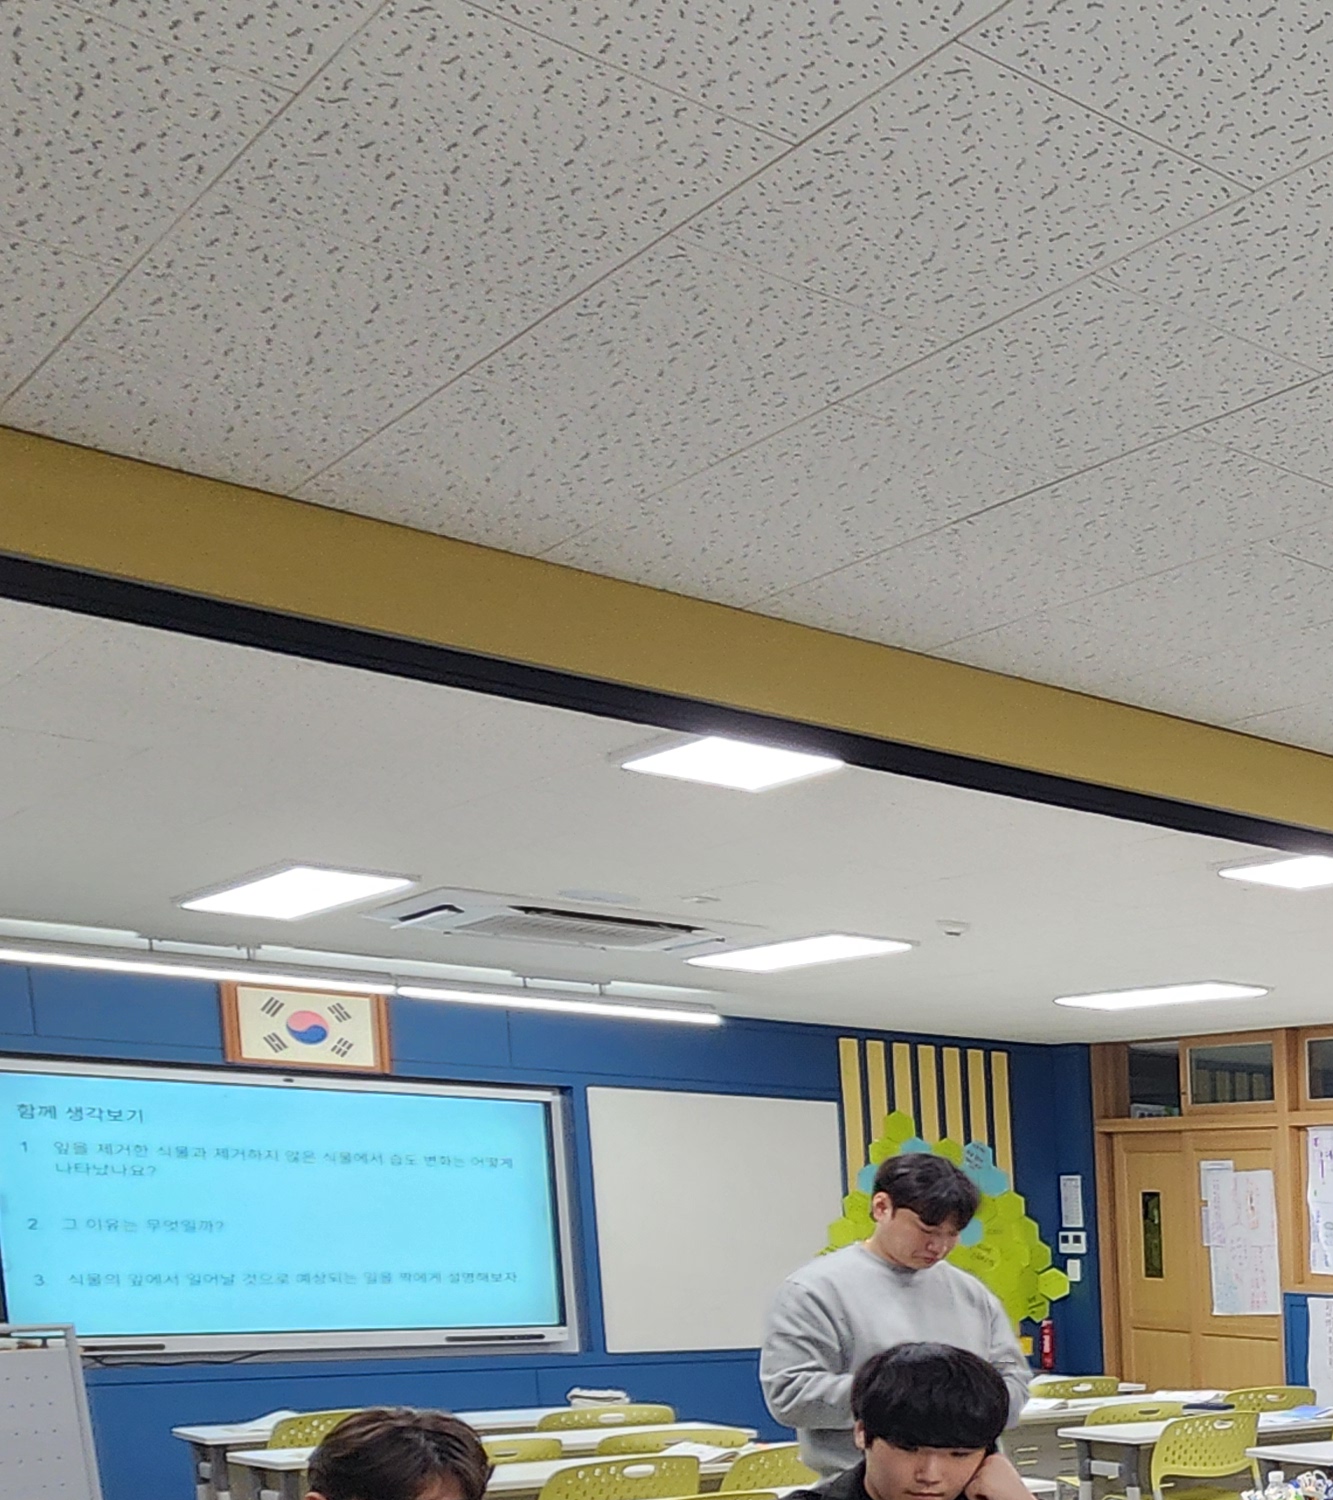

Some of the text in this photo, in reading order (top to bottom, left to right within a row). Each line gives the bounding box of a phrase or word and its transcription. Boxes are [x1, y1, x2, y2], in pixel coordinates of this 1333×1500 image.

[16, 1103, 144, 1124] 함께 생각보기
[53, 1141, 88, 1156] 잎을
[97, 1143, 149, 1158] 제거한
[157, 1145, 207, 1160] 식물과
[214, 1147, 279, 1162] 제거하지
[284, 1150, 316, 1164] 않은
[323, 1151, 384, 1166] 식물에서
[55, 1162, 157, 1177] 나타났나요?
[61, 1218, 78, 1231] 그
[86, 1218, 138, 1233] 이유는
[146, 1218, 225, 1233] 무엇일까?
[68, 1273, 121, 1287] 식물의
[127, 1273, 180, 1287] 잎에서
[187, 1273, 235, 1287] 일어날
[243, 1272, 289, 1286] 것으로
[295, 1271, 358, 1285] 예상되는
[364, 1271, 392, 1285] 일을
